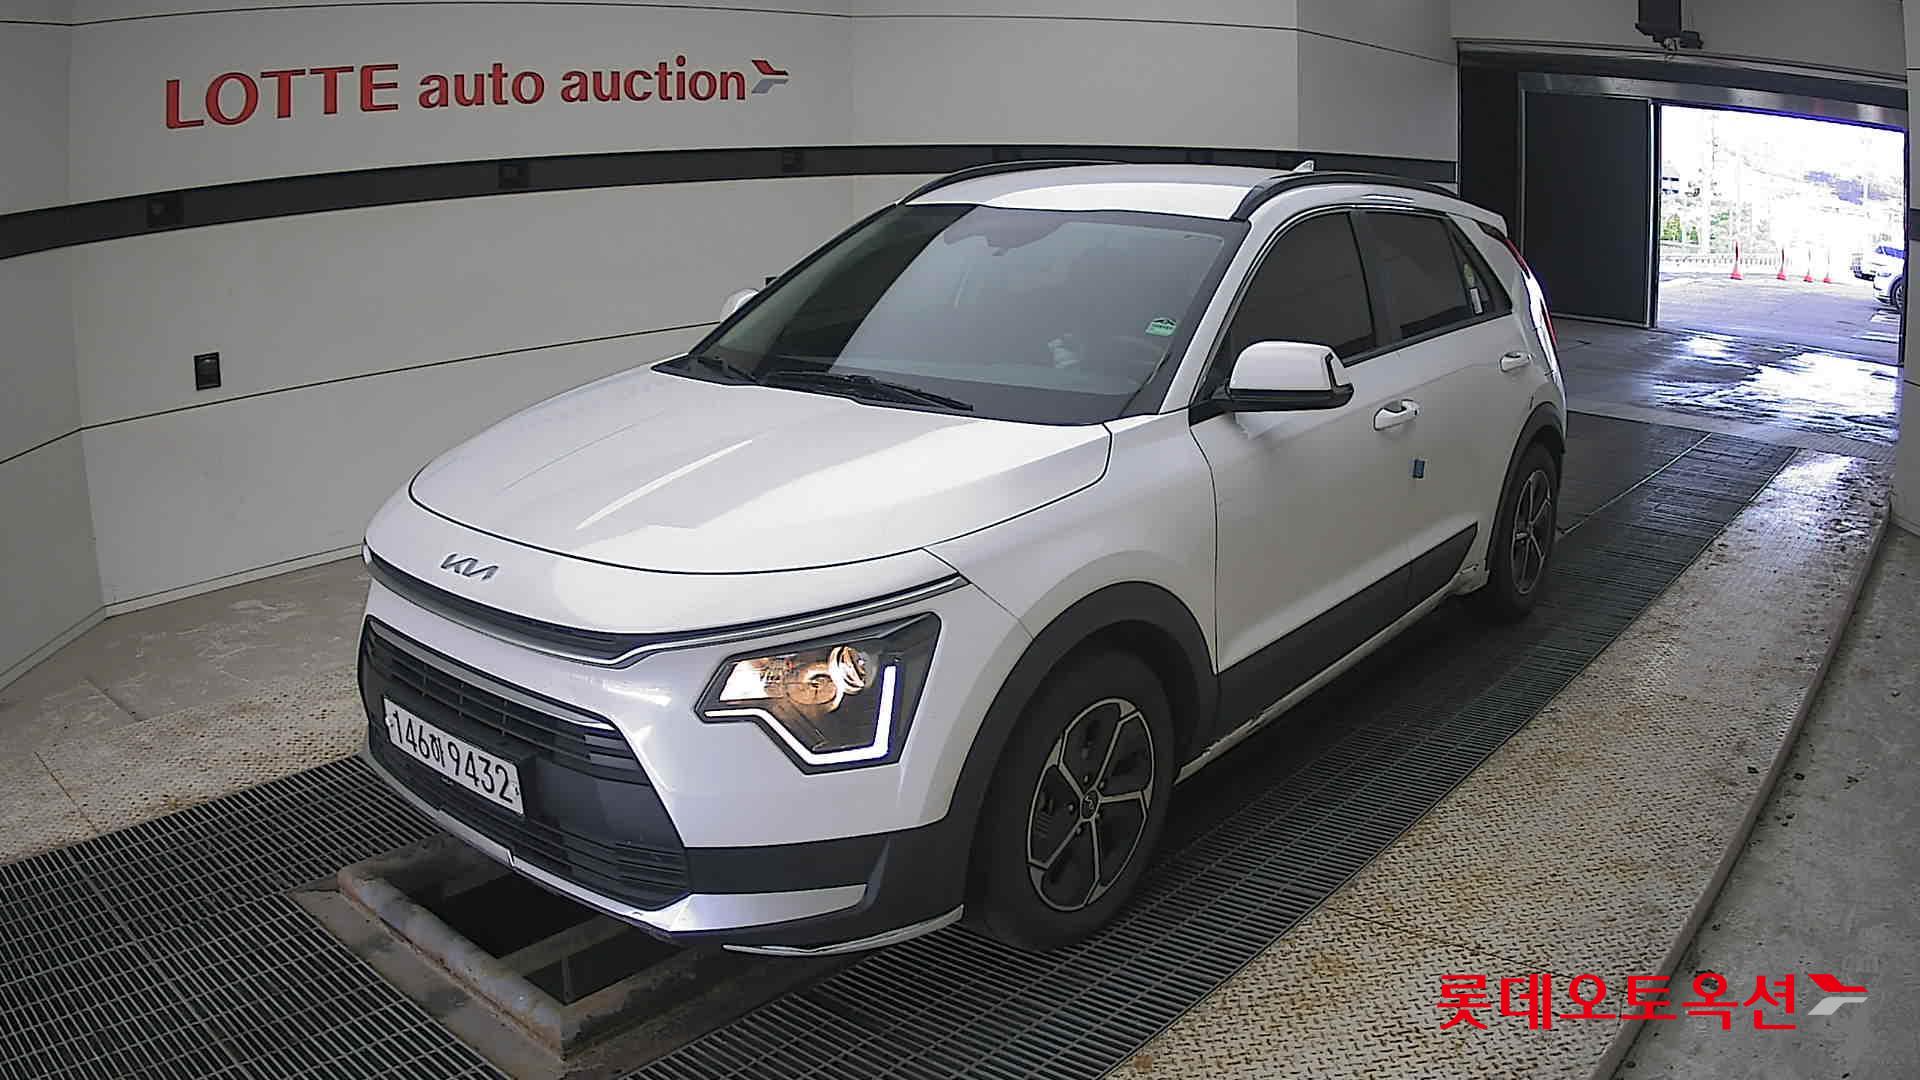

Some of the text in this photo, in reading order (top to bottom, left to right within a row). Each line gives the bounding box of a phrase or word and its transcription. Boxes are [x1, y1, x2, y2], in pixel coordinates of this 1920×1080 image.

[164, 54, 747, 130] LOTTE auto auction
